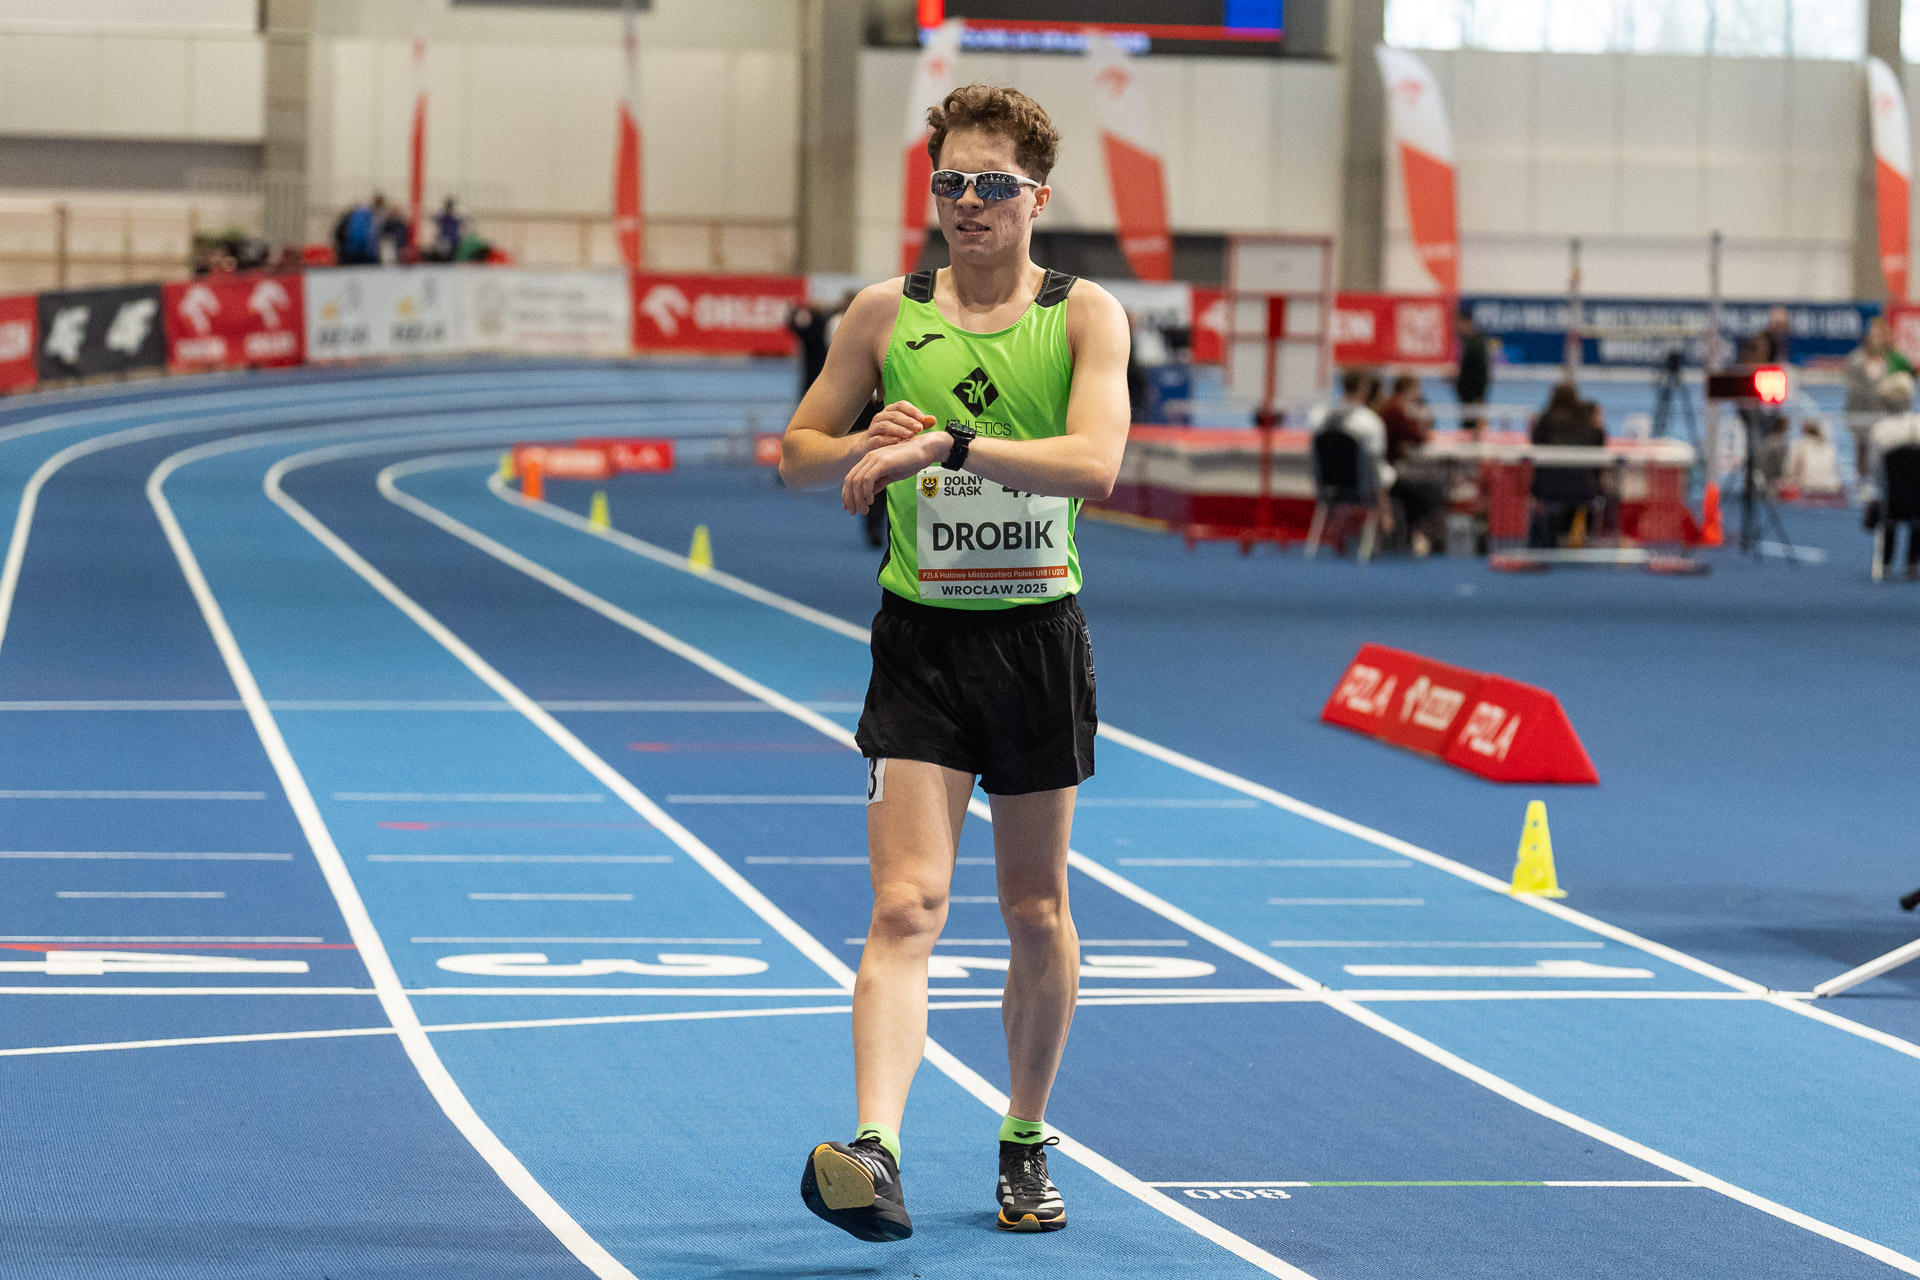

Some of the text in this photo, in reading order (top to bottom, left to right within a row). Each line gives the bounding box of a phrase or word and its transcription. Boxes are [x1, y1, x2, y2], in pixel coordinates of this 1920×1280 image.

[946, 419, 1012, 436] ETICS
[944, 476, 984, 486] DOLNY
[944, 484, 982, 498] ŚLĄSK
[932, 520, 1055, 551] DROBIK
[940, 571, 967, 579] Halowe
[967, 571, 1012, 579] Mistrzostwa
[1035, 569, 1048, 577] U18
[1052, 568, 1065, 576] U20
[941, 582, 1048, 596] WROCŁAW 2025
[435, 952, 770, 978] 3
[1342, 959, 1657, 979] 1
[1182, 1188, 1292, 1200] 800
